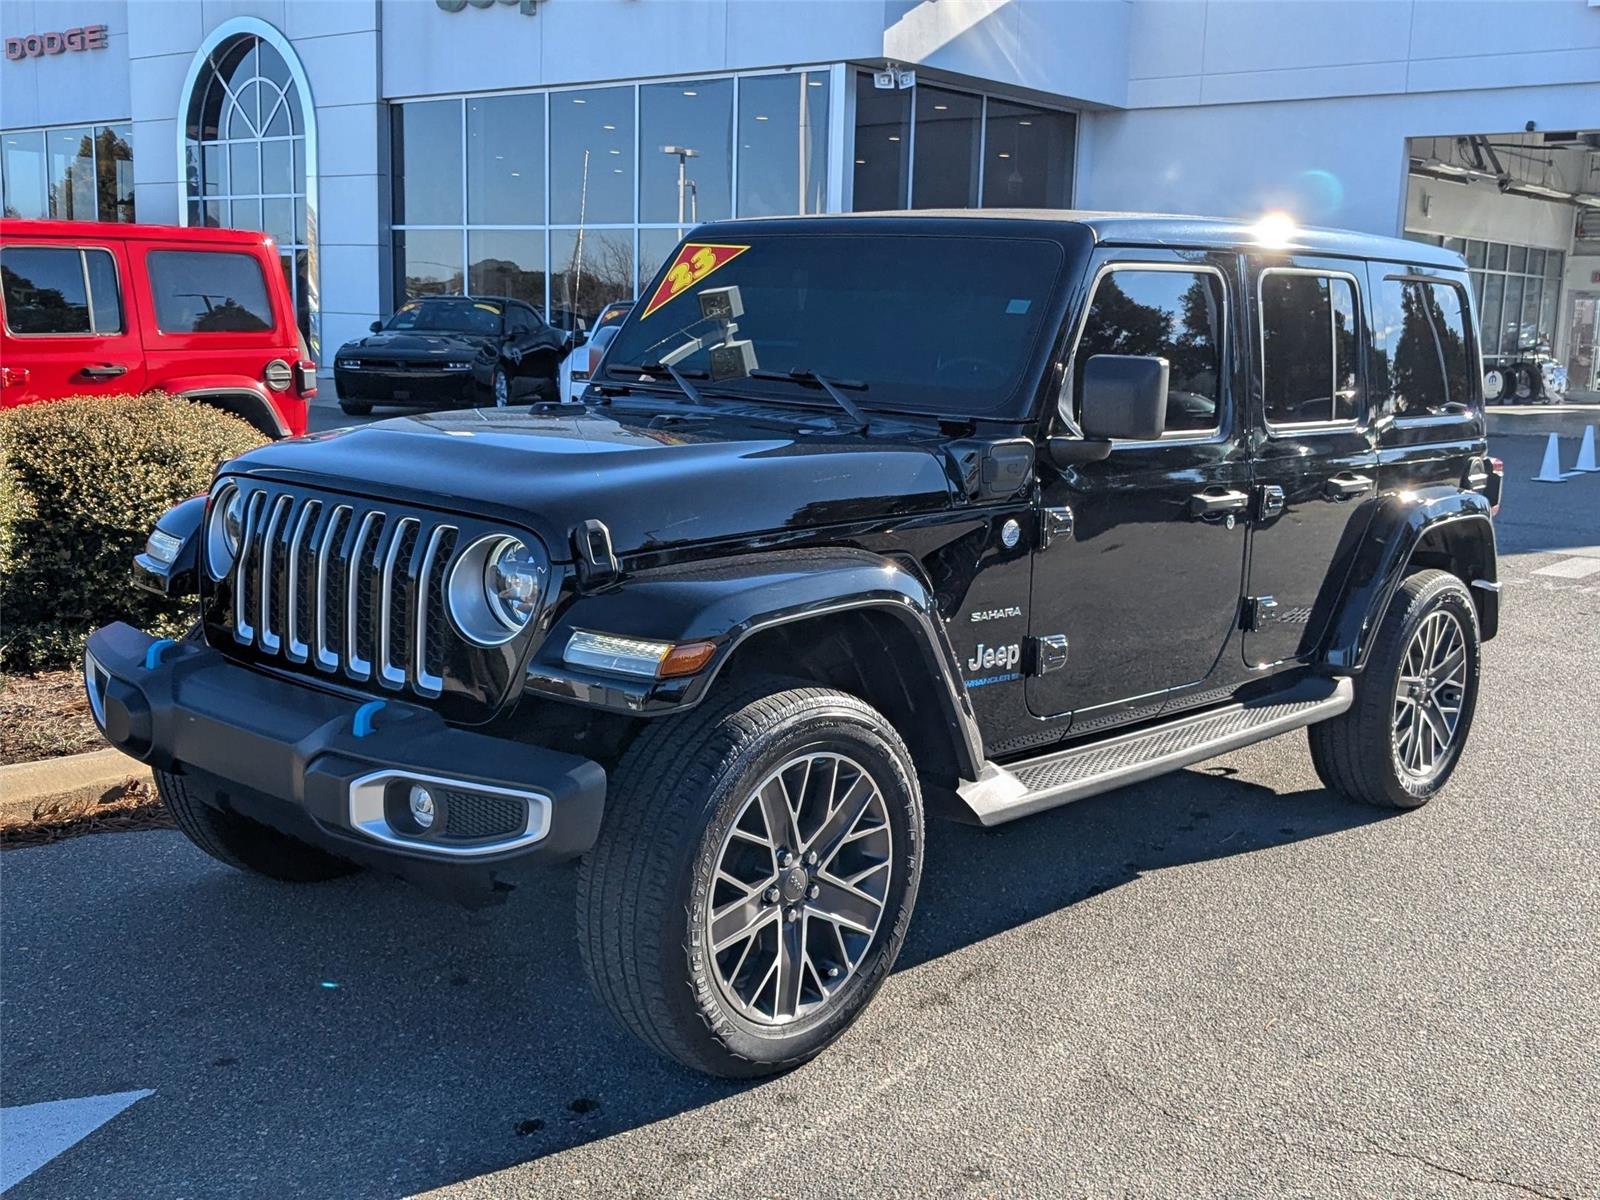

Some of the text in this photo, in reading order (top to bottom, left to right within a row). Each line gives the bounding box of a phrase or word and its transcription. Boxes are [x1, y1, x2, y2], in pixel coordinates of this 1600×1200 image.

[5, 24, 109, 60] DODGE
[668, 247, 717, 293] 23
[971, 607, 1021, 621] SAHARA
[969, 643, 1020, 672] Jeep
[964, 674, 1011, 688] WRANGLER
